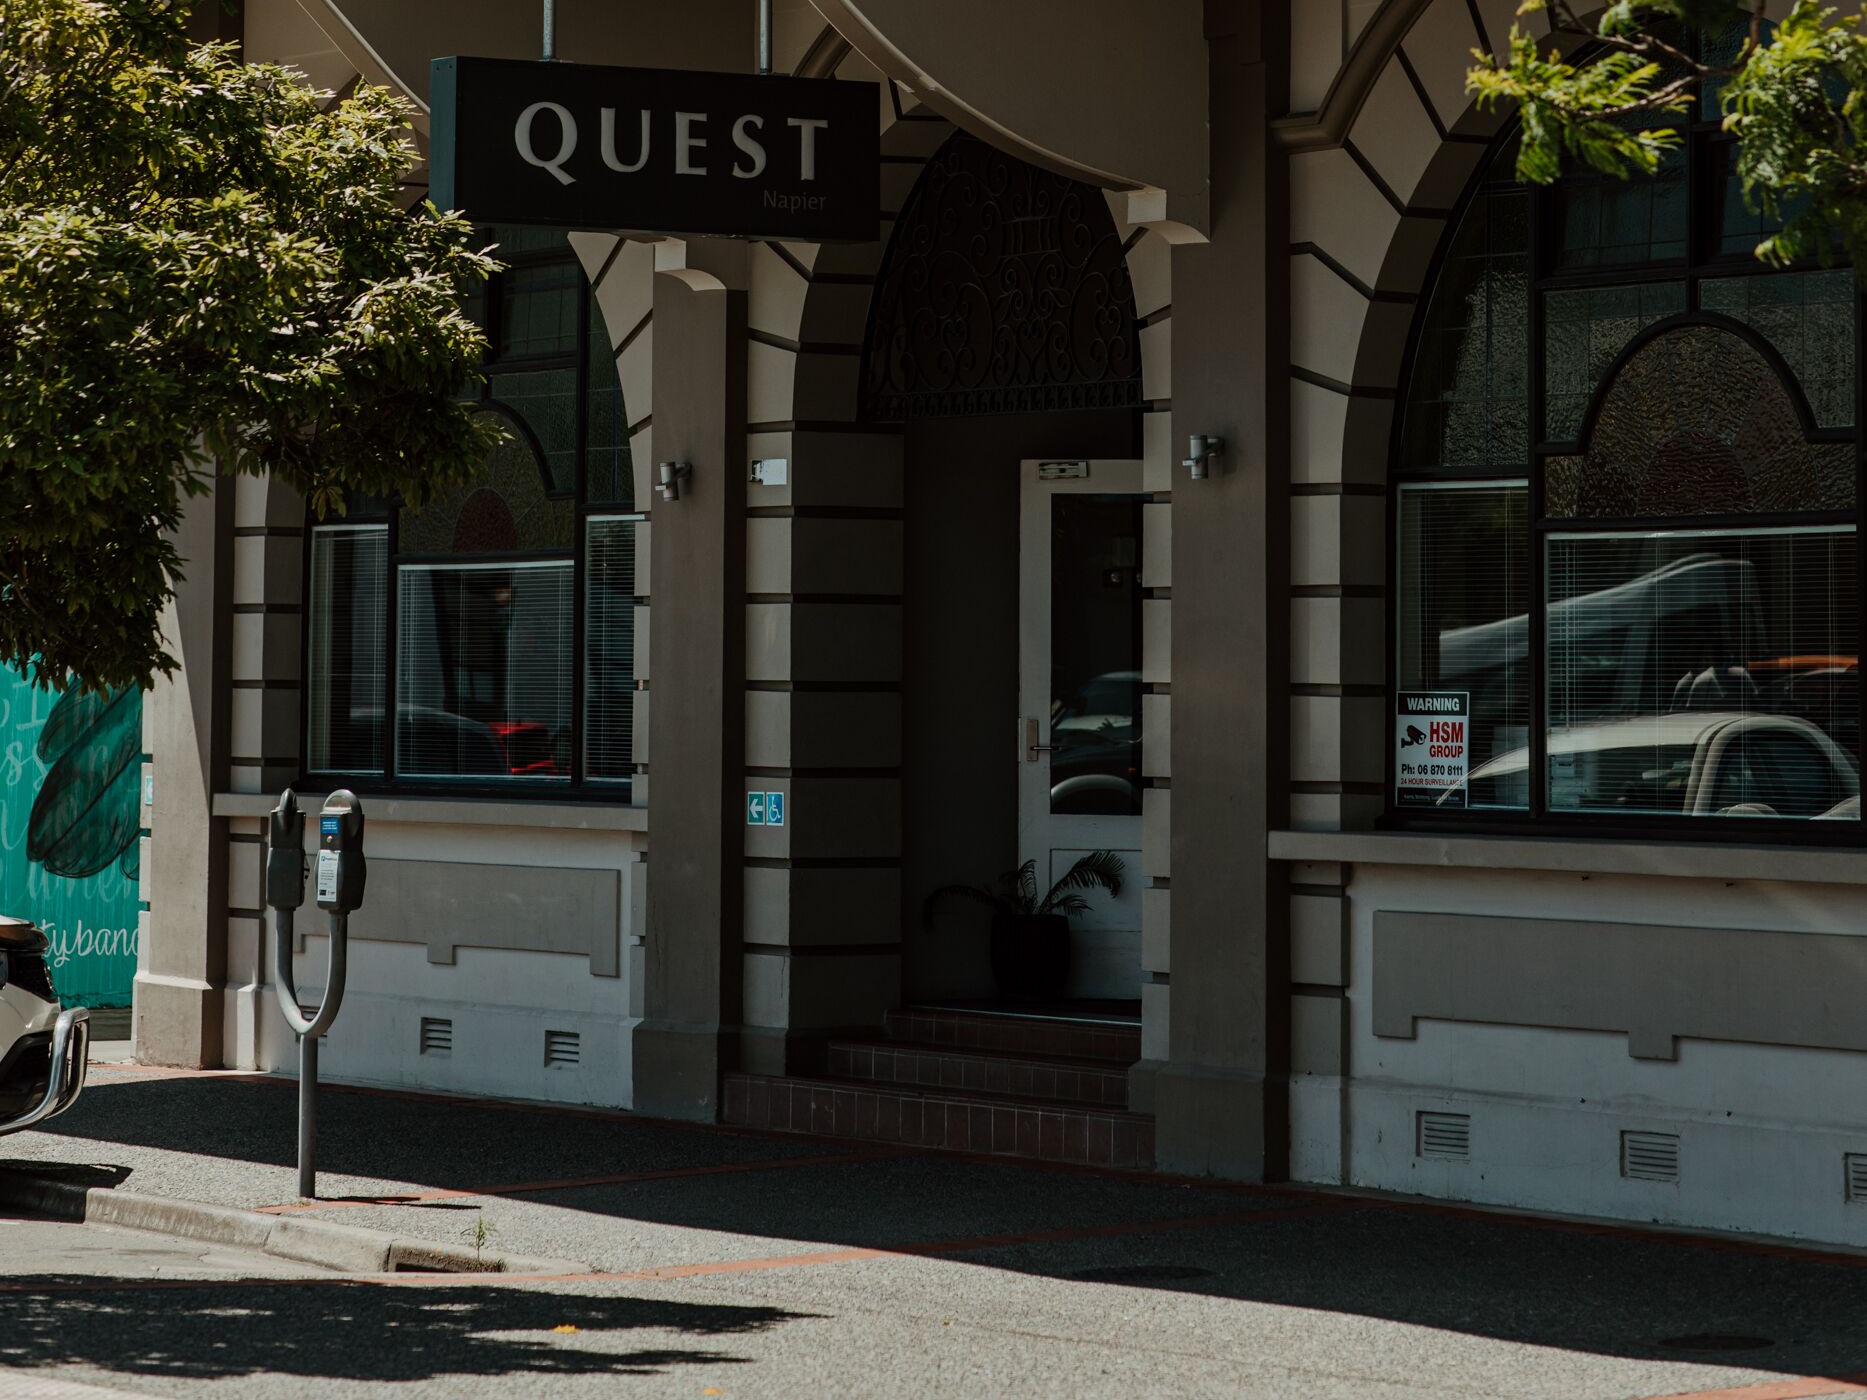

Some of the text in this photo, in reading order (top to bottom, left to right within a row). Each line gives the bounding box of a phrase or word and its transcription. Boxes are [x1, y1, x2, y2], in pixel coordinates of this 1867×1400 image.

[514, 102, 828, 185] QUEST
[763, 190, 827, 214] Napier
[1407, 697, 1460, 711] WARNING
[1429, 721, 1464, 743] HSM
[1429, 745, 1464, 758] GROUP
[1401, 764, 1463, 776] Ph: 06 870 8111
